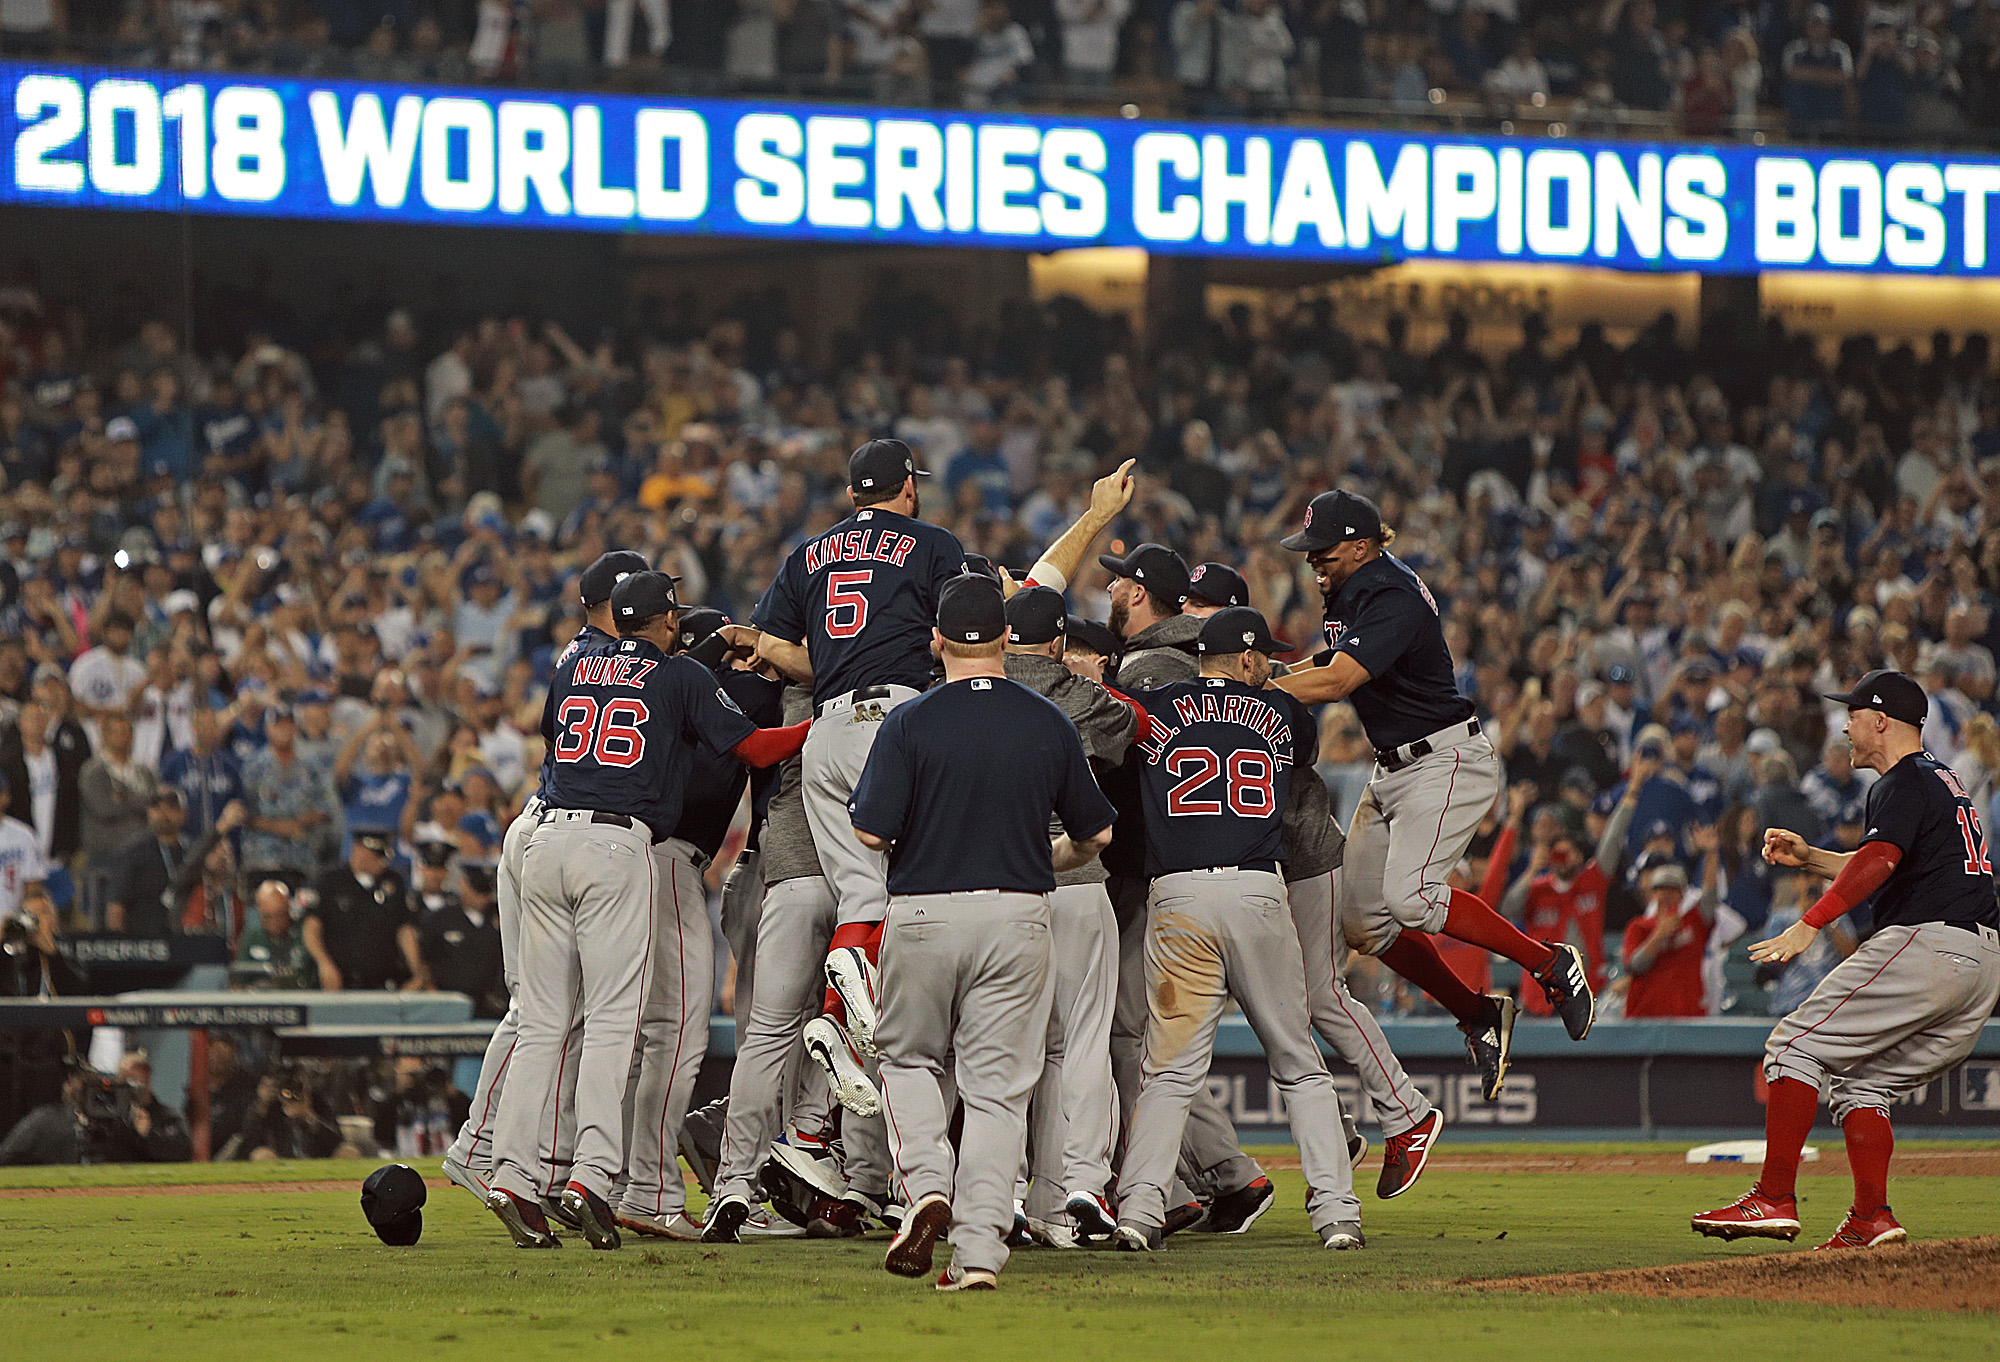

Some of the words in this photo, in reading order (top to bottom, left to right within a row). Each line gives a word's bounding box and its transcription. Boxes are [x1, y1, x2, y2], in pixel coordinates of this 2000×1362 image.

[14, 73, 286, 201] 2018
[307, 90, 709, 220] WORLD
[733, 112, 1107, 237] SERIES
[1132, 131, 1728, 261] CHAMPIONS
[1753, 156, 2000, 268] BOST
[805, 529, 917, 575] KINSLER
[825, 569, 874, 640] 5
[571, 654, 659, 690] NUÑEZ
[554, 695, 651, 769] 36
[1172, 693, 1294, 773] MARTINEZ
[1165, 746, 1277, 819] 28
[1333, 1074, 1537, 1124] SRIES
